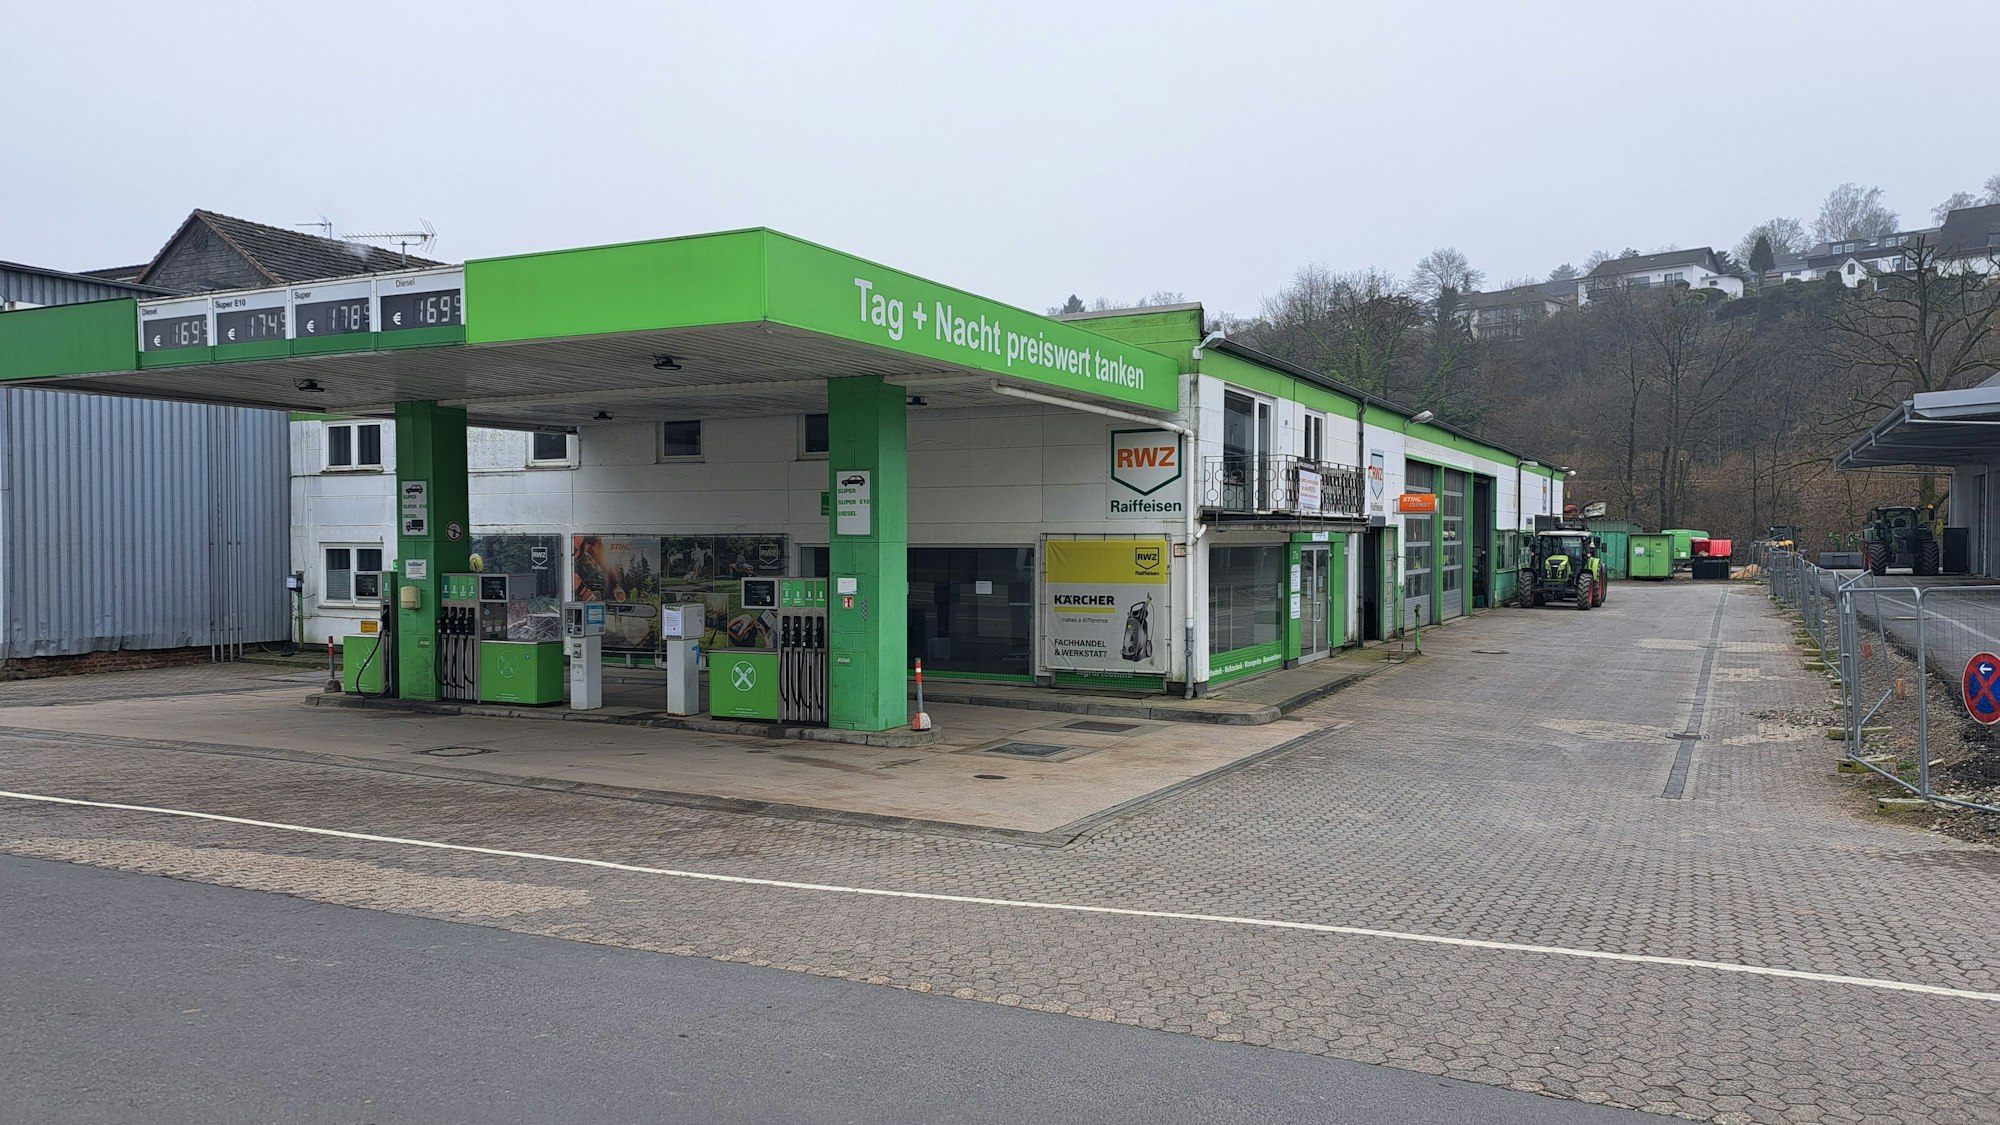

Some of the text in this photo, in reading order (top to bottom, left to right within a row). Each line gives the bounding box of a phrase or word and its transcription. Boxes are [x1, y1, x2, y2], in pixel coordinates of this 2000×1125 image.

[396, 278, 415, 288] Diesel
[294, 291, 312, 300] Super
[215, 298, 246, 310] Super E10
[142, 307, 158, 316] Diesel
[854, 277, 1144, 391] Tag + Nacht preiswert tanken
[1117, 446, 1175, 468] RWZ
[1110, 499, 1182, 513] Raiffeisen
[609, 543, 632, 551] STIHL
[1137, 553, 1157, 561] RWZ
[1054, 594, 1115, 605] KÄRCHER
[1082, 616, 1109, 624] difference
[1054, 638, 1107, 648] FACHHANDEL
[1054, 648, 1108, 658] & WERKSTATT
